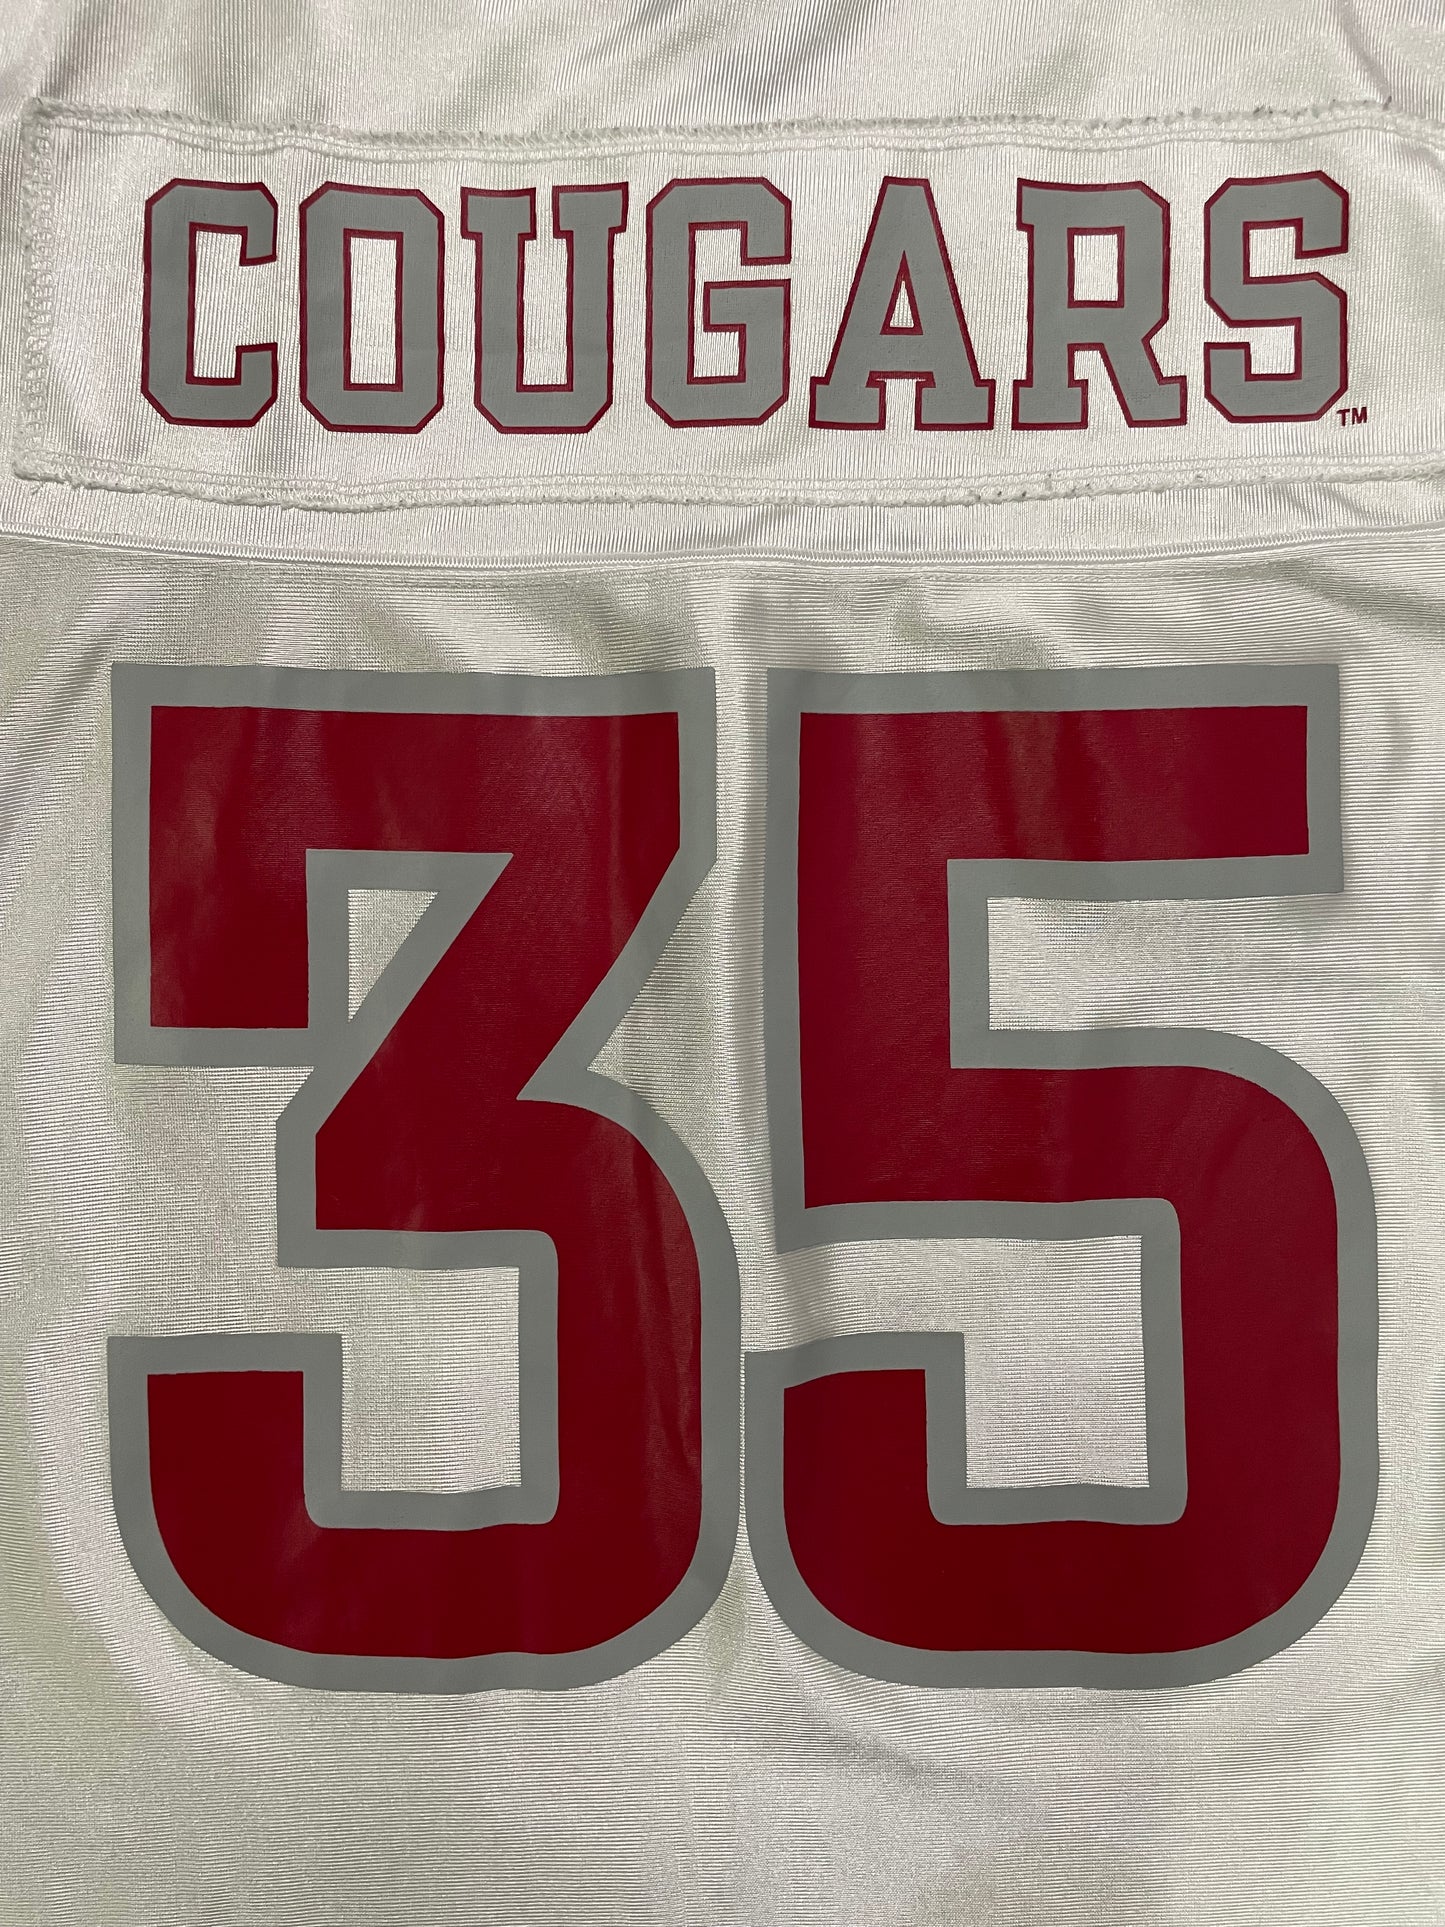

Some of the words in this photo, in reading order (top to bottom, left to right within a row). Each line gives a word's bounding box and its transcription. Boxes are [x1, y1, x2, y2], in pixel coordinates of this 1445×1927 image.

[141, 171, 1350, 435] COUGARS
[1336, 406, 1368, 427] TM
[107, 664, 1378, 1694] 35
